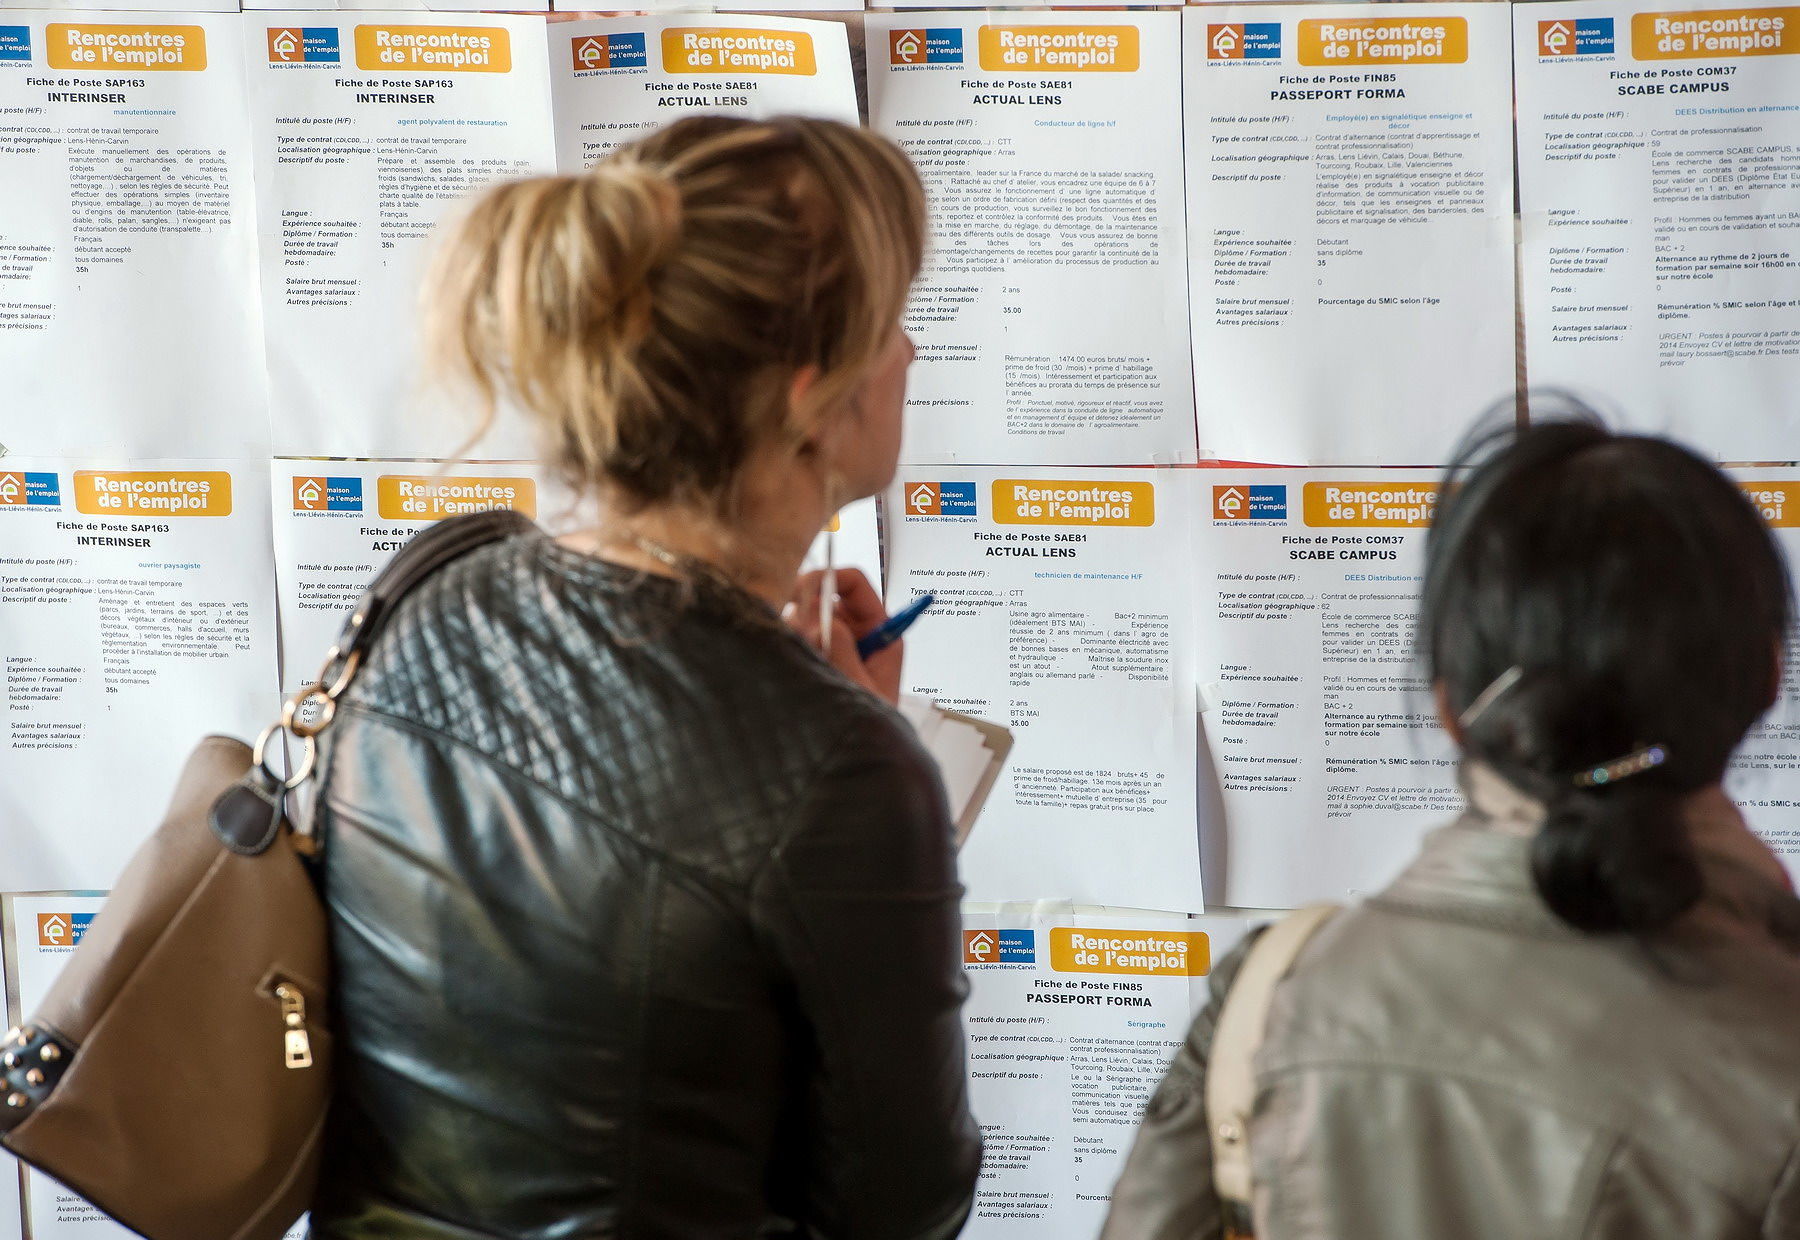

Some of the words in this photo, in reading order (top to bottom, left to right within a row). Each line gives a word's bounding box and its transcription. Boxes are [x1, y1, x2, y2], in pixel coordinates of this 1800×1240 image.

[1320, 24, 1445, 41] Rencontres
[1655, 16, 1784, 35] Rencontres
[68, 30, 185, 47] Rencontres
[377, 31, 490, 49] Rencontres
[684, 34, 795, 51] Rencontres
[1000, 31, 1118, 47] Rencontres
[1658, 35, 1685, 52] de
[1693, 31, 1780, 52] l'emploi
[71, 47, 96, 62] de
[102, 47, 182, 66] l'emploi
[380, 48, 405, 63] de
[412, 49, 488, 67] l'emploi
[1003, 48, 1028, 64] de
[1035, 49, 1114, 68] l'emploi
[1323, 42, 1349, 58] de
[1357, 40, 1442, 60] l'emploi
[688, 50, 712, 65] de
[719, 50, 795, 69] l'emploi
[1365, 74, 1396, 82] FIN85
[1697, 67, 1736, 75] COM37
[106, 79, 144, 87] SAP163
[415, 80, 453, 88] SAP163
[1619, 85, 1664, 95] SCABE
[1670, 82, 1729, 93] CAMPUS
[48, 93, 125, 103] INTERINSER
[357, 94, 434, 103] INTERINSER
[658, 97, 710, 106] ACTUAL
[715, 97, 747, 105] LENS
[973, 95, 1024, 104] ACTUAL
[1029, 96, 1061, 104] LENS
[1271, 90, 1352, 100] PASSEPORT
[1357, 89, 1405, 98] FORMA
[94, 477, 210, 492] Rencontres
[400, 482, 515, 498] Rencontres
[1014, 486, 1132, 502] Rencontres
[1326, 488, 1437, 504] Rencontre
[98, 493, 121, 507] de
[128, 493, 207, 512] l'emploi
[403, 498, 426, 512] de
[1017, 502, 1042, 517] de
[1049, 502, 1129, 521] l'emploi
[1329, 504, 1355, 519] de
[1362, 505, 1433, 523] l'empl
[78, 537, 151, 547] INTERINSER
[1283, 536, 1311, 544] Fiche
[1315, 536, 1327, 544] de
[1332, 536, 1362, 544] Poste
[1366, 536, 1404, 544] COM37
[986, 547, 1038, 556] ACTUAL
[1043, 548, 1076, 557] LENS
[1290, 551, 1334, 559] SCABE
[1340, 551, 1396, 559] CAMPUS
[1072, 934, 1187, 952] Rencontres
[1075, 950, 1099, 965] de
[1106, 952, 1185, 971] l'emploi
[1035, 980, 1062, 988] Fiche
[1113, 983, 1142, 991] FIN85
[1027, 994, 1102, 1004] PASSEPORT
[1107, 997, 1151, 1006] FORMA
